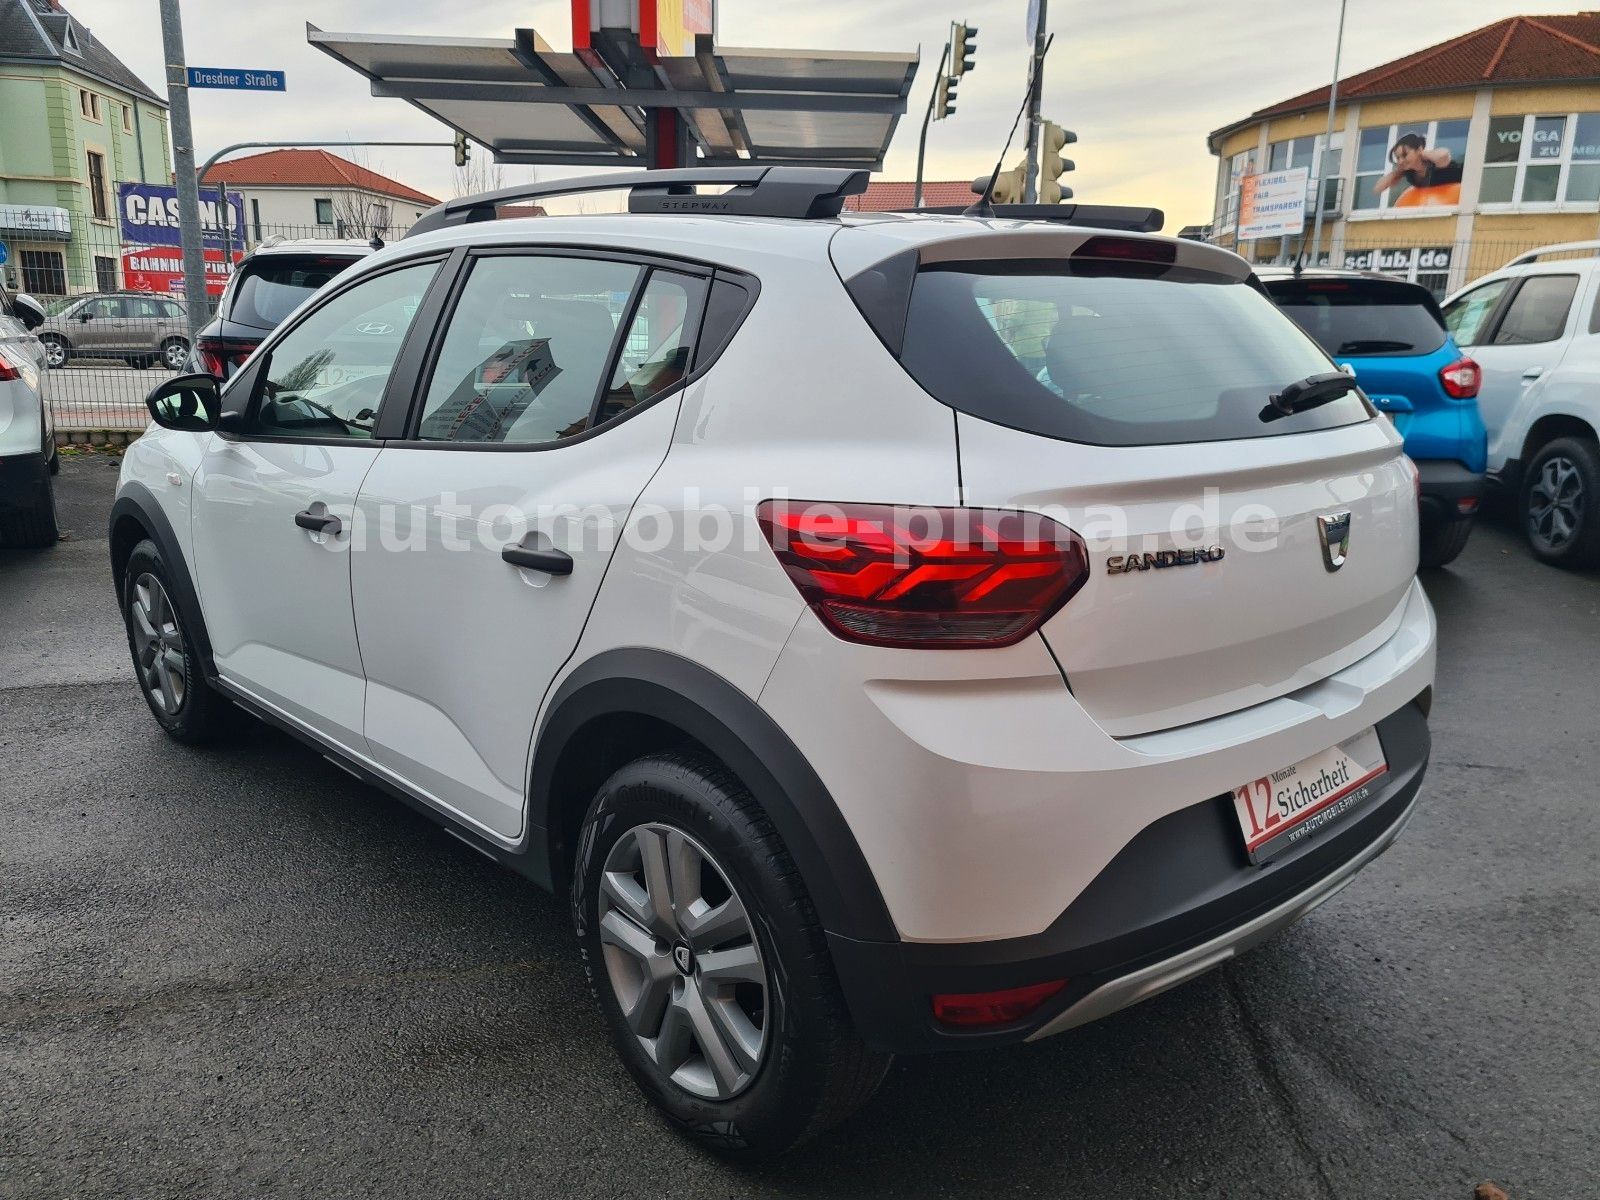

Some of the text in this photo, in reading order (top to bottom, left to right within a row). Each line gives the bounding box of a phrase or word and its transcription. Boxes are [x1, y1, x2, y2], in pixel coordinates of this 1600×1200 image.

[194, 71, 278, 87] Dresdner Straße
[1497, 130, 1559, 143] YOGA
[126, 194, 237, 232] CASNO
[1253, 200, 1302, 213] TRANSPARENT
[1107, 544, 1225, 574] SANDERO
[1237, 766, 1297, 838] 12 Monate
[1276, 759, 1350, 817] Sicherheit
